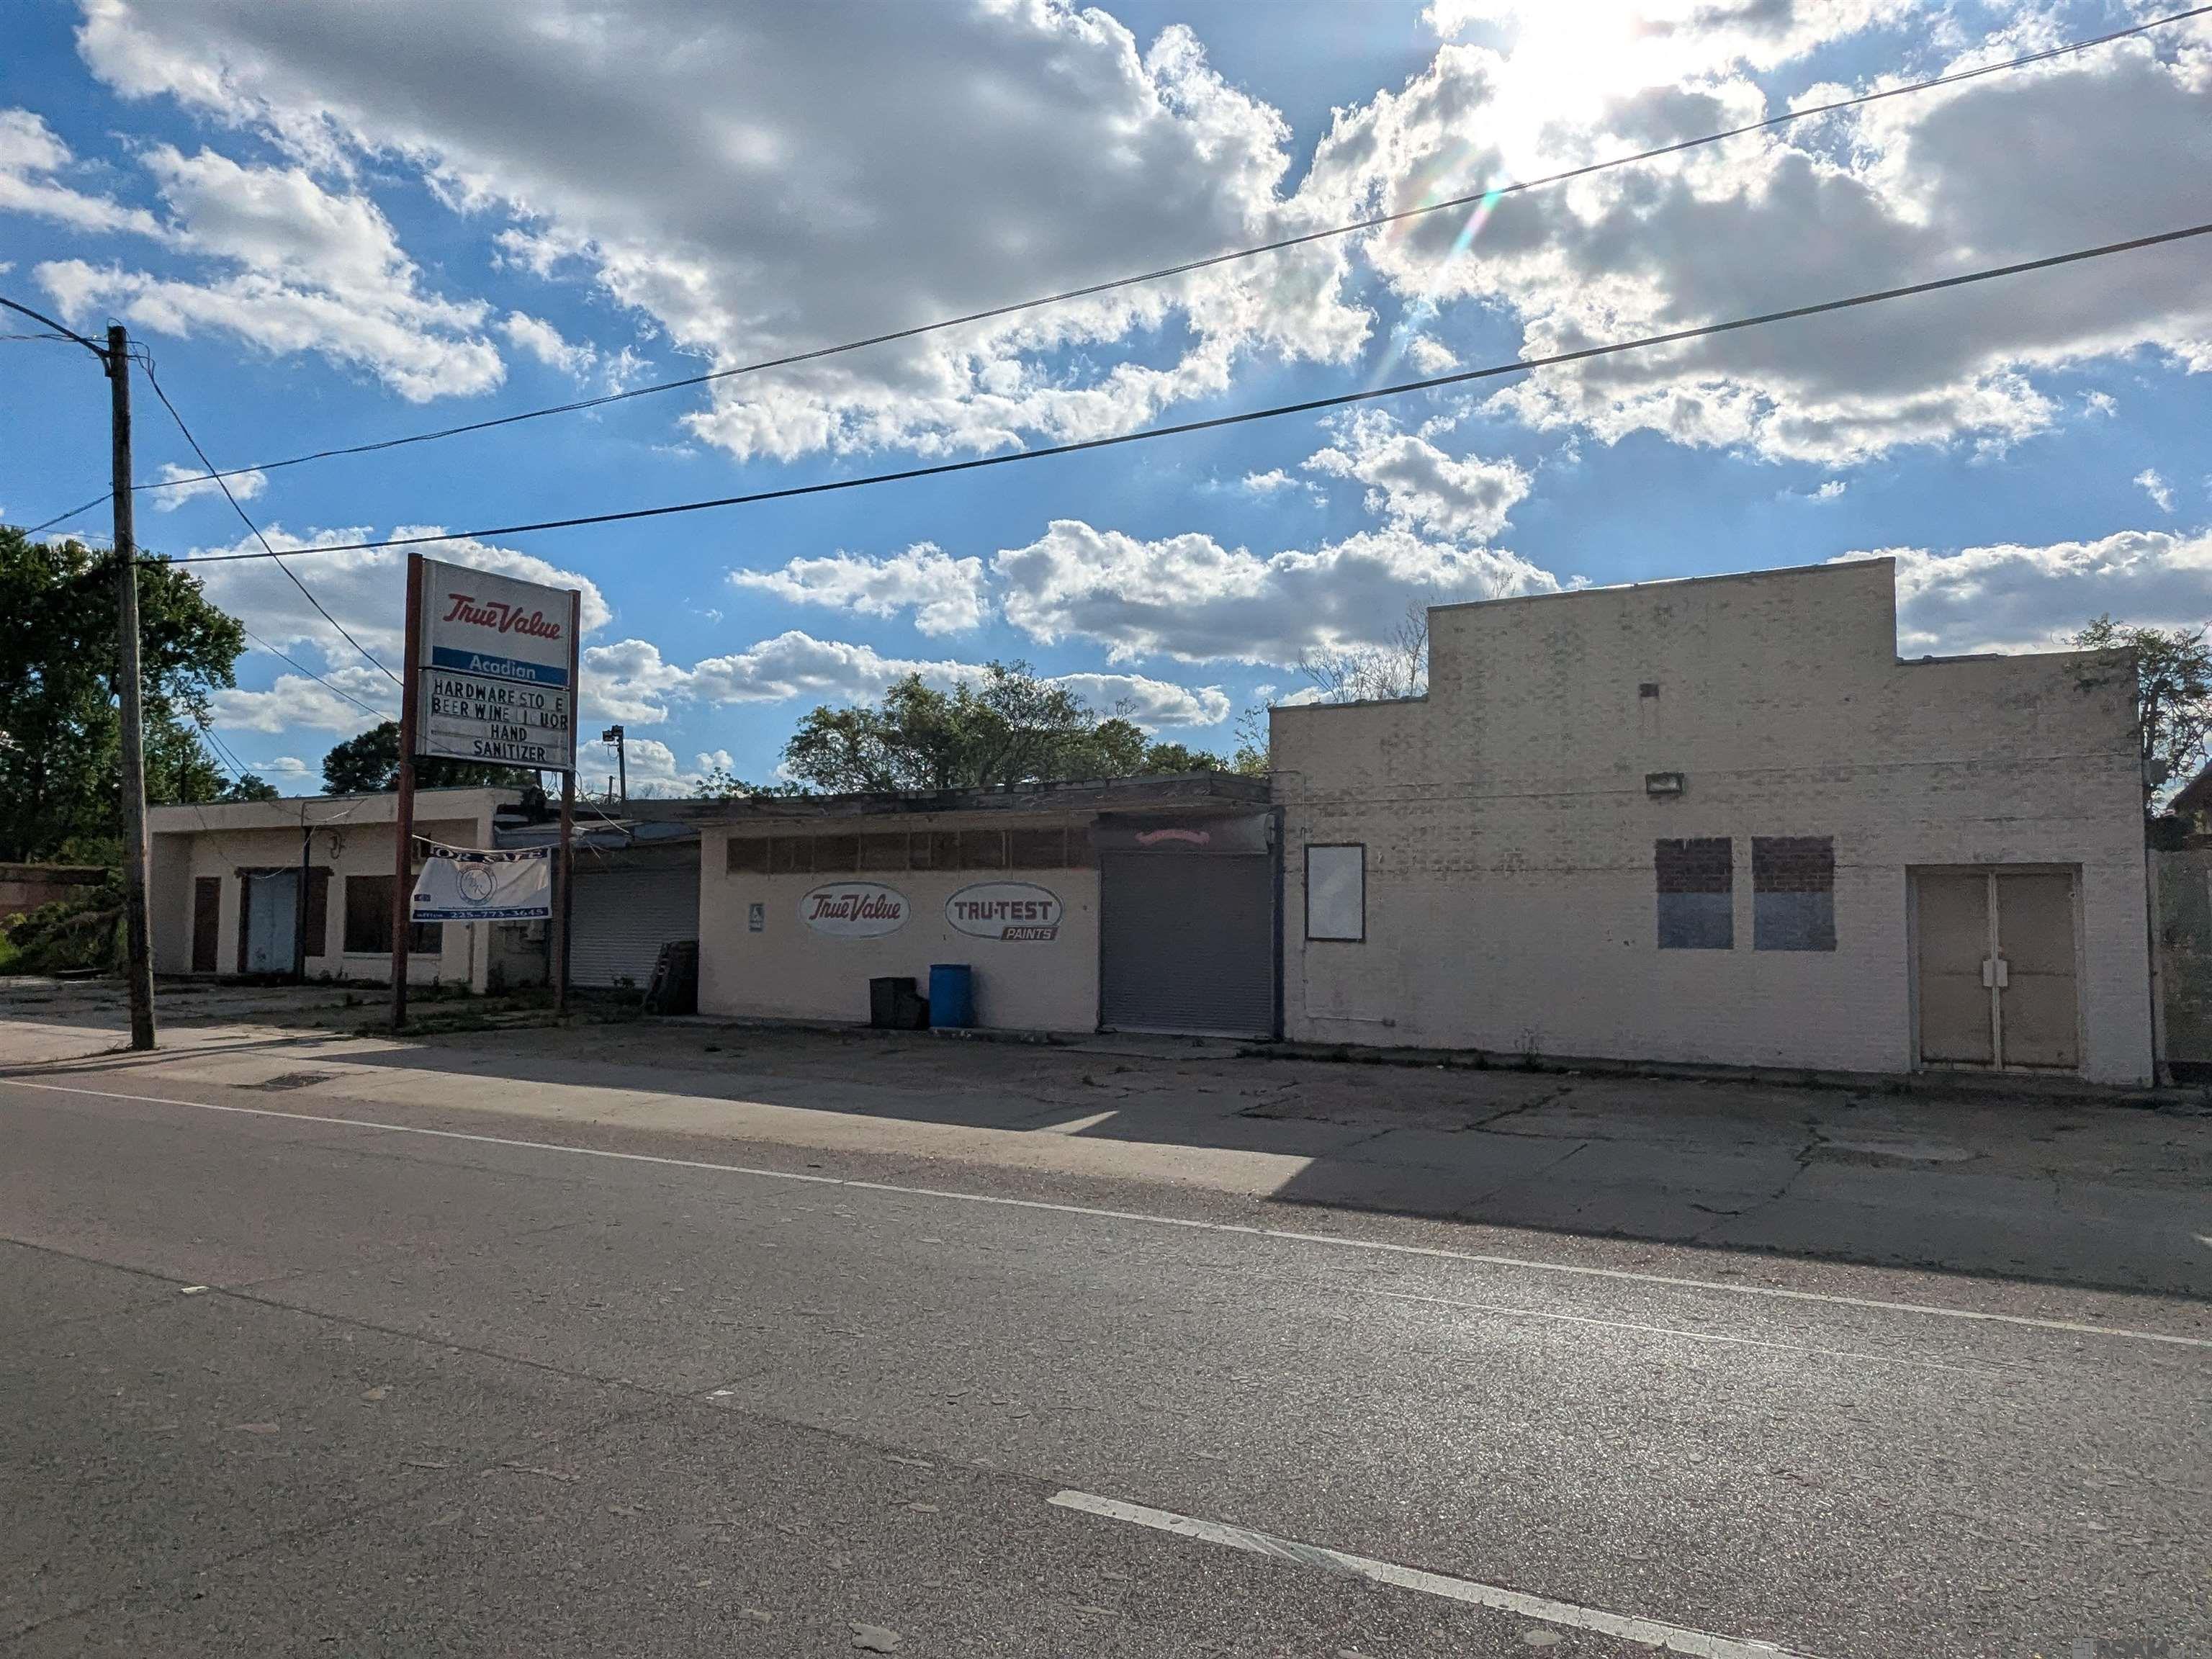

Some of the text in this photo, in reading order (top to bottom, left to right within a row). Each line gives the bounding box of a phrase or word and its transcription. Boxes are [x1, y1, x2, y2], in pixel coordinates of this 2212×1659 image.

[469, 655, 536, 680] Acadian
[434, 679, 563, 711] HARDWARE STOE
[431, 696, 567, 729] BEER WINE LIUOR
[491, 724, 527, 742] HAND
[474, 740, 547, 762] SANITIZER
[1006, 927, 1053, 940] PAINTS
